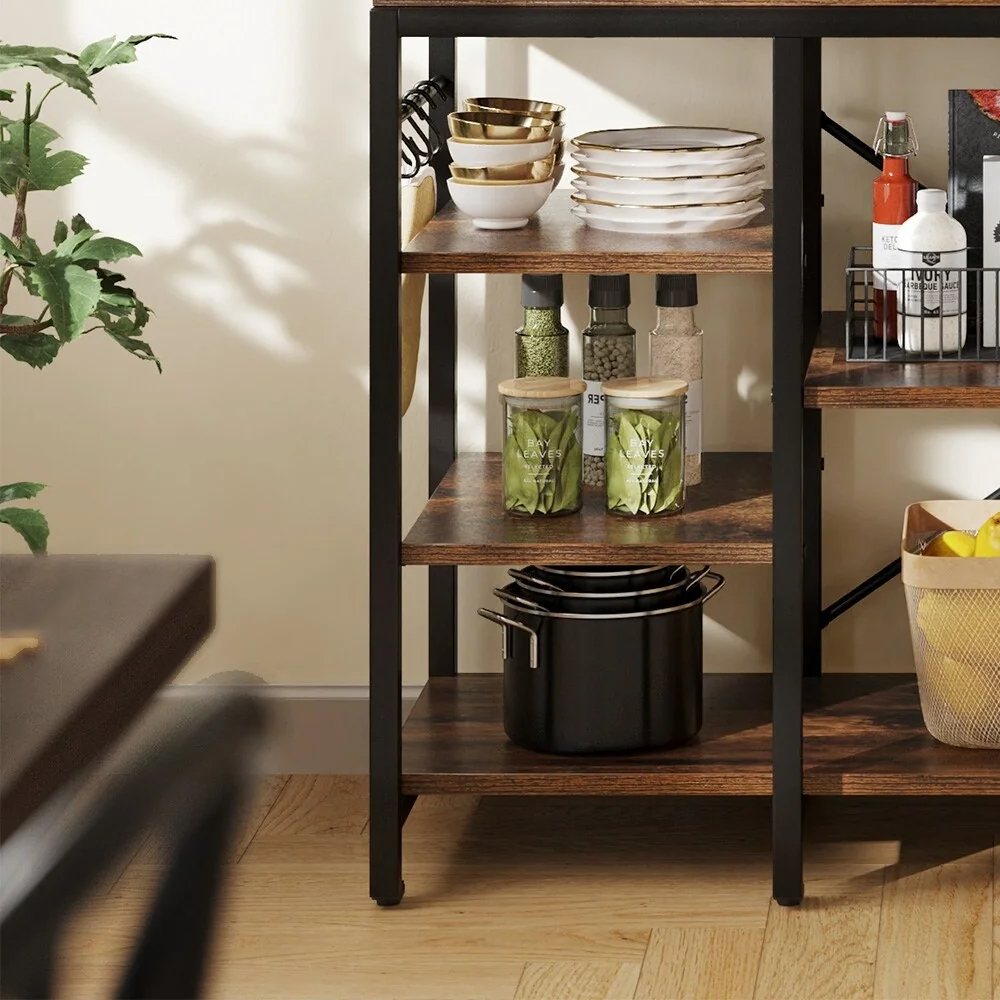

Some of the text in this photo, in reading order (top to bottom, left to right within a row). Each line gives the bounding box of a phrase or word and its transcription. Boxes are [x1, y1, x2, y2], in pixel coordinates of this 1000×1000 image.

[903, 281, 938, 290] ARBEQUE
[528, 439, 551, 447] BAY
[631, 439, 653, 447] BAY
[517, 450, 562, 458] LEAVES
[620, 450, 664, 458] LEAVES
